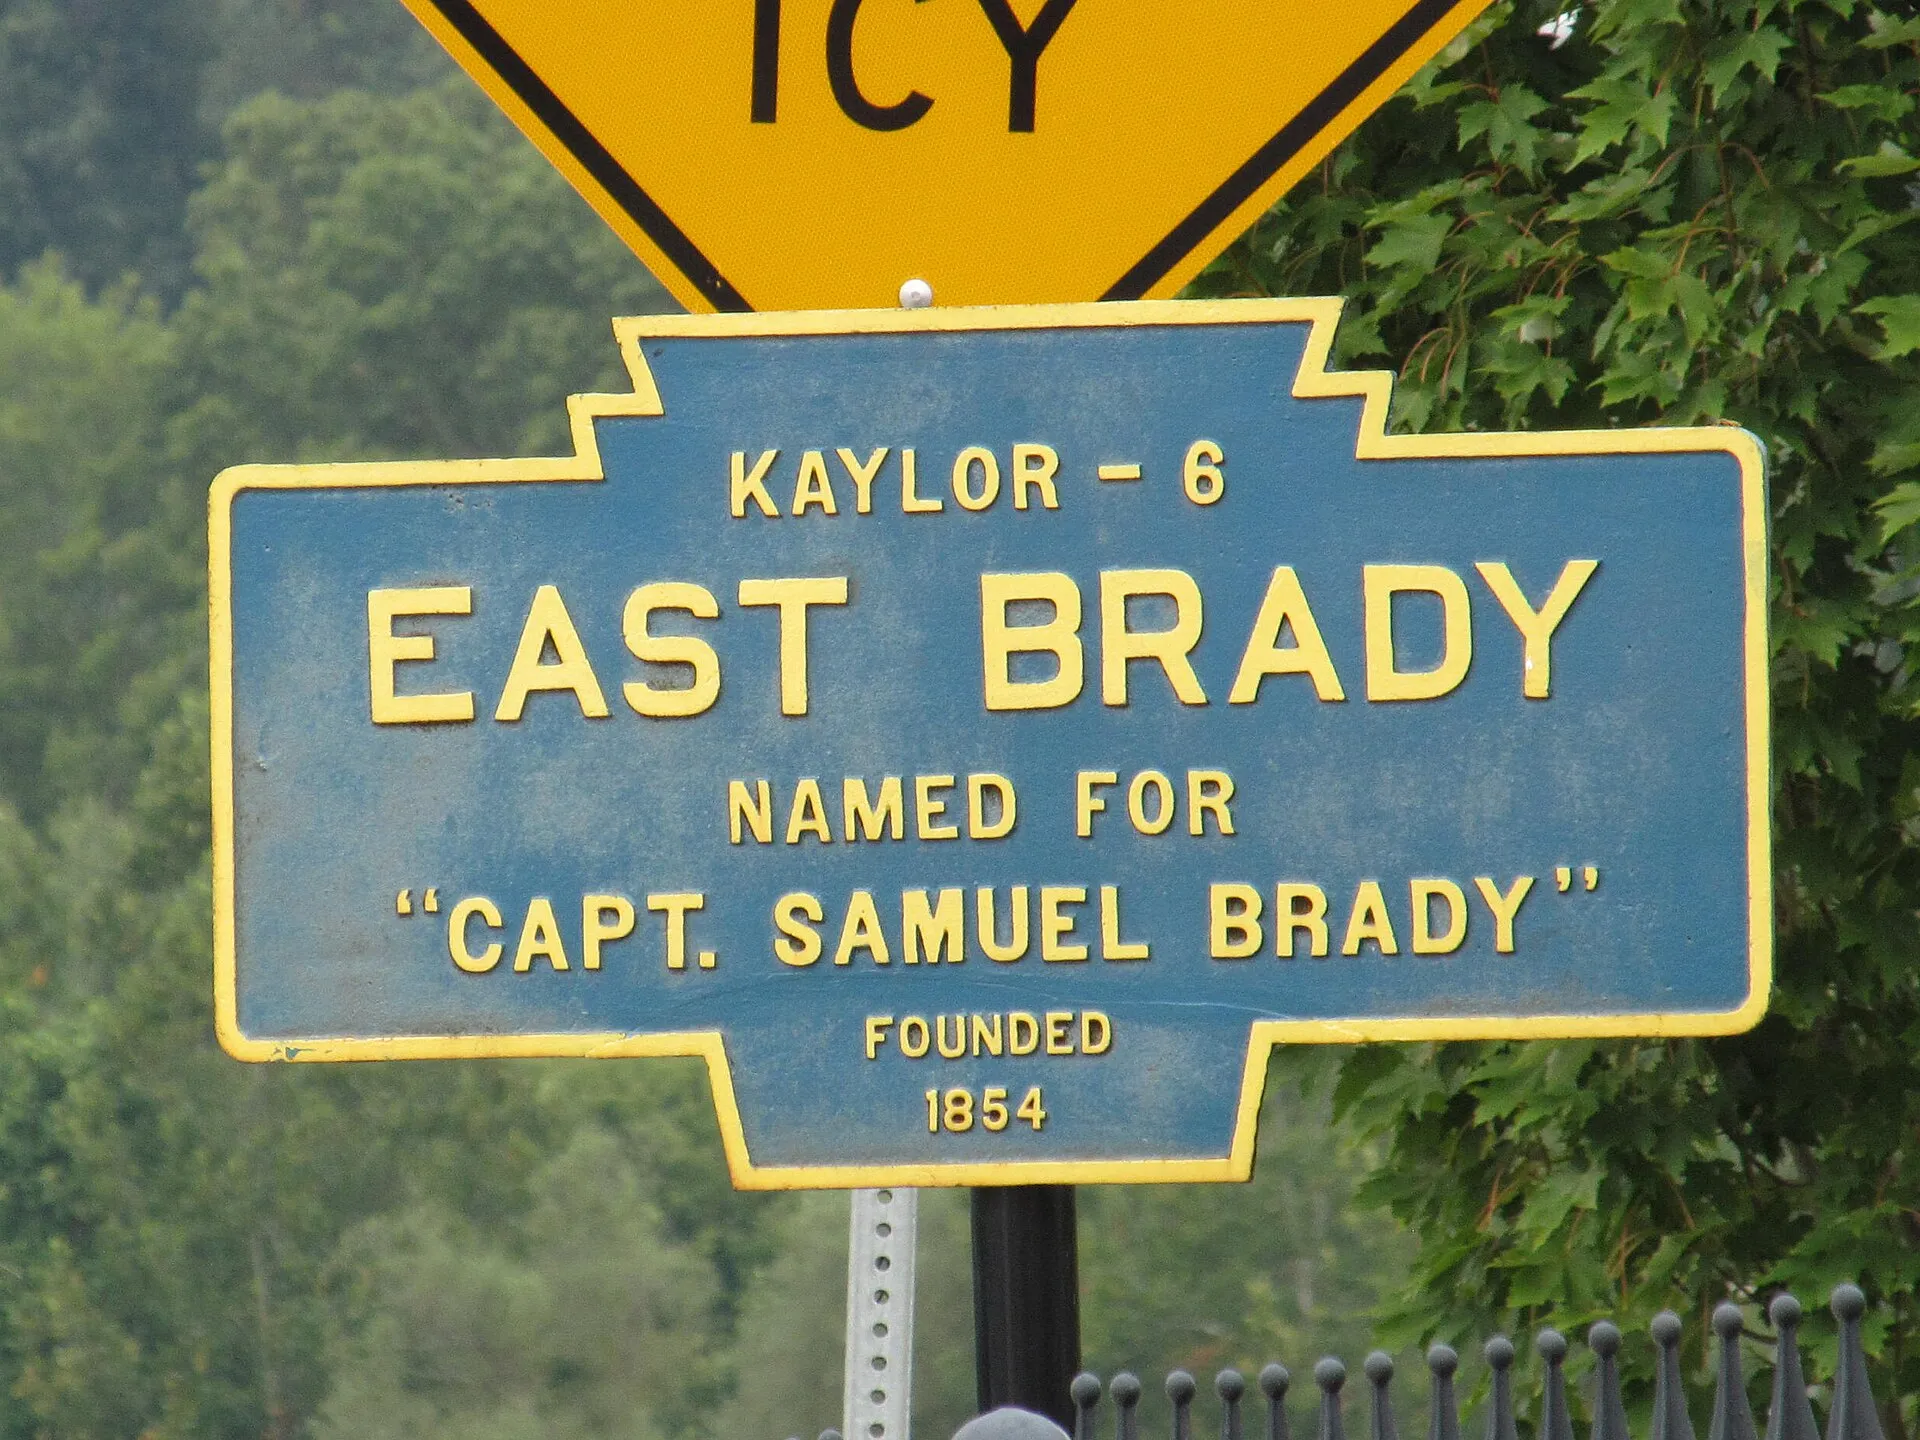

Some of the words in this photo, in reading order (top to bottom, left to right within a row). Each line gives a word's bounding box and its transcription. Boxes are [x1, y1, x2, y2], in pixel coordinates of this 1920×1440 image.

[750, 0, 1078, 133] ICY
[729, 443, 1059, 518] KAYLOR
[1183, 438, 1225, 505] 6
[367, 575, 849, 724] EAST
[980, 559, 1599, 711] BRADY
[729, 772, 1017, 845] NAMED
[1076, 769, 1236, 838] FOR
[774, 884, 1150, 968] SAMUEL
[865, 1010, 1112, 1059] FOUNDED
[925, 1085, 1047, 1132] 1854
